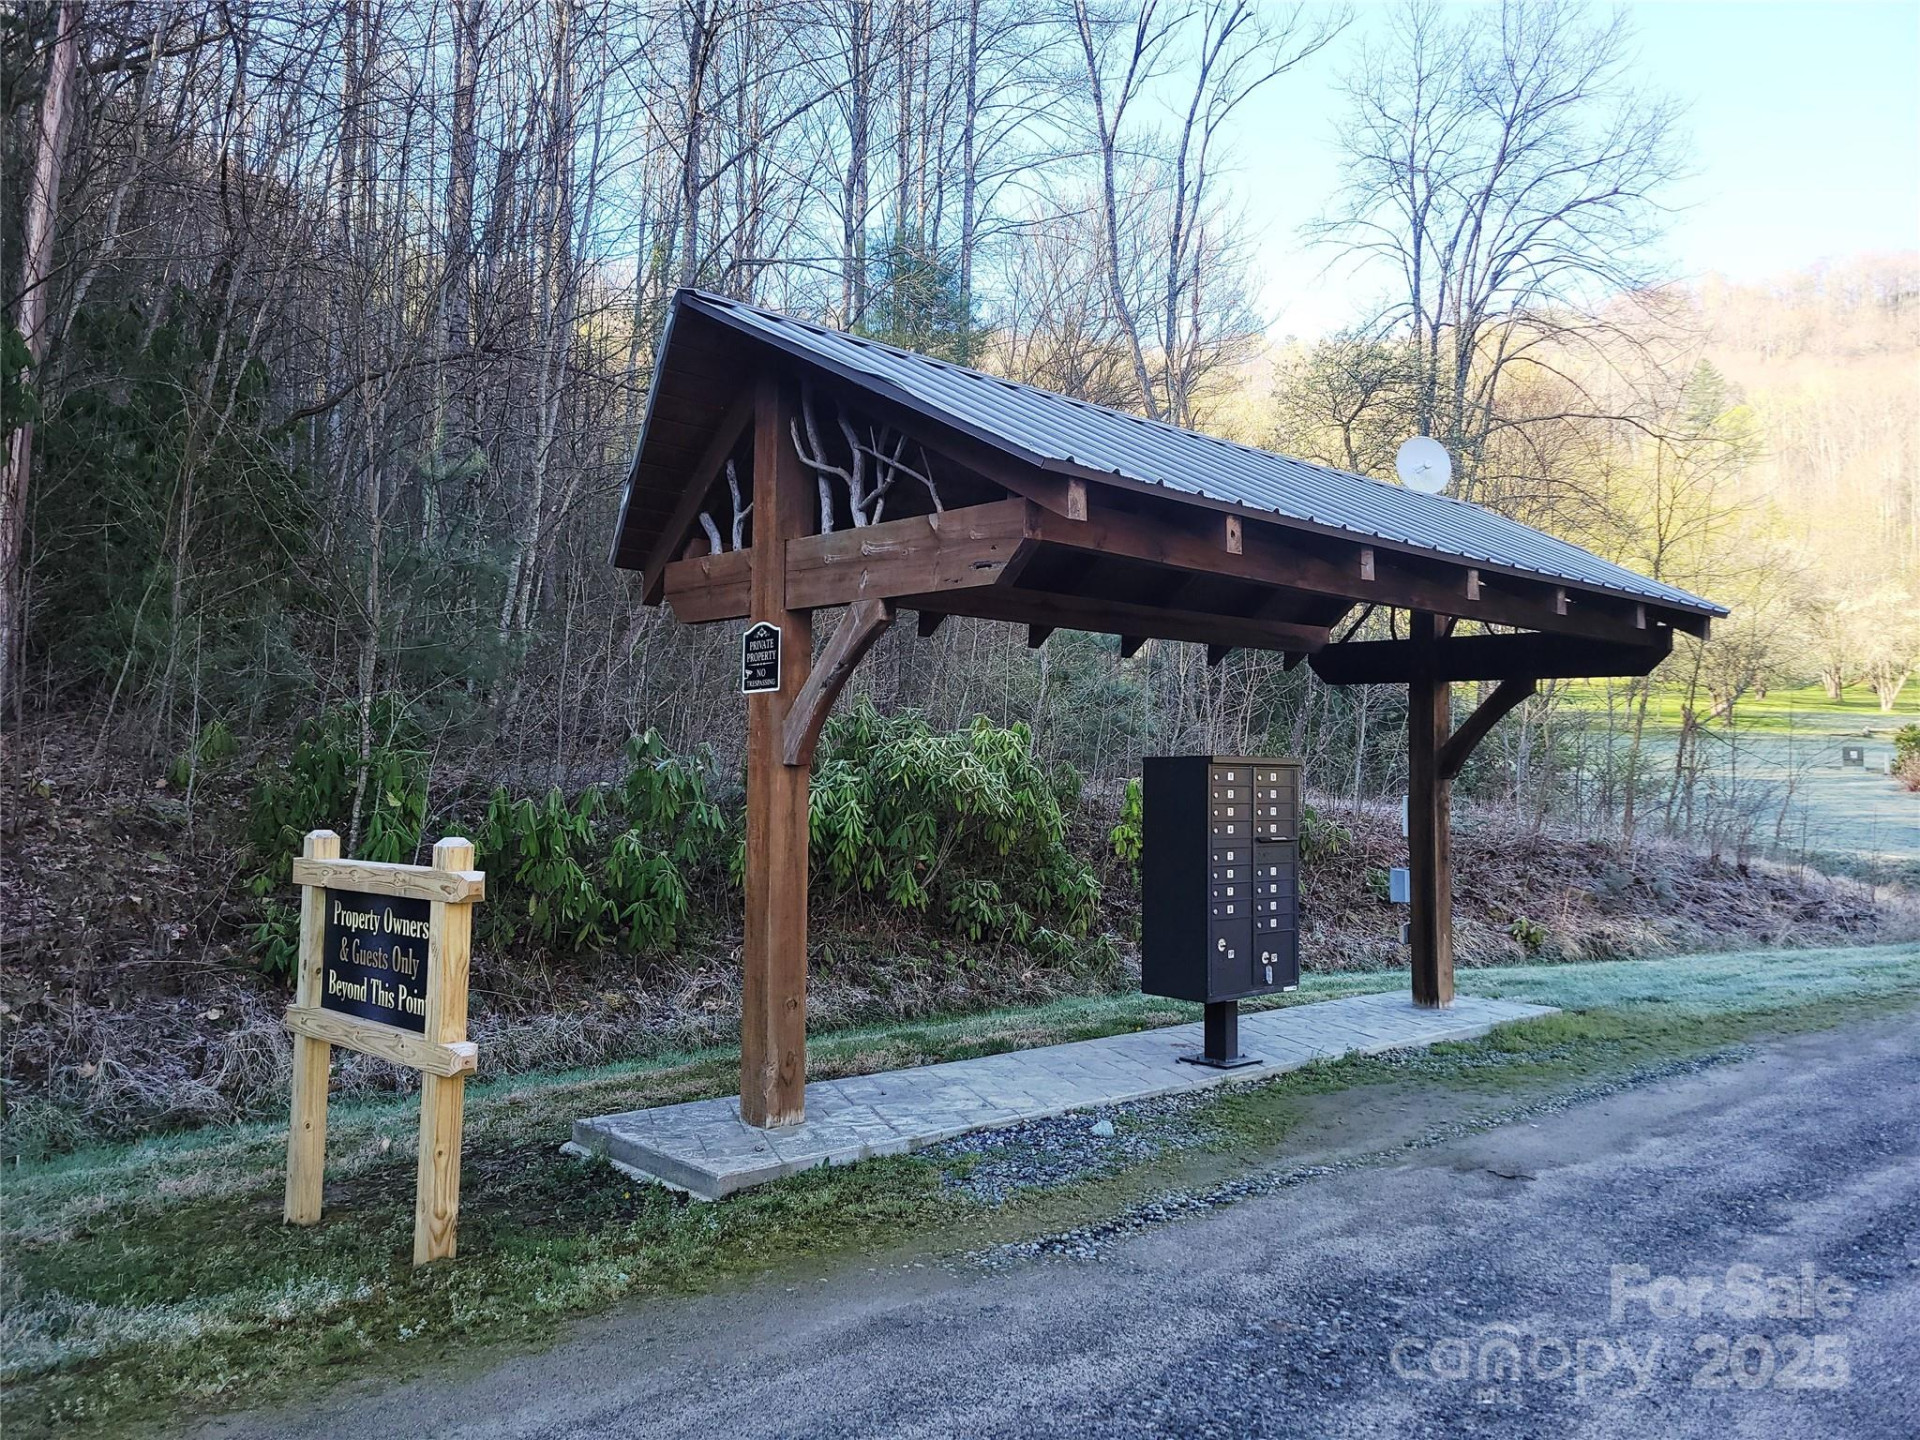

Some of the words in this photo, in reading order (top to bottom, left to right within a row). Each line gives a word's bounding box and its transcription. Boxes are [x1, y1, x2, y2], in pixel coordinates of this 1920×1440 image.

[750, 638, 774, 651] PRIVATE
[747, 650, 776, 663] PROPERTY
[757, 668, 766, 677] NO
[747, 678, 775, 688] TRESPASSING
[334, 900, 380, 935] Property
[384, 907, 429, 939] Owners
[340, 937, 349, 962] &
[352, 938, 388, 970] Guests
[393, 945, 419, 980] Only
[329, 969, 367, 1002] Beyond
[371, 978, 395, 1009] This
[398, 984, 426, 1016] Poin
